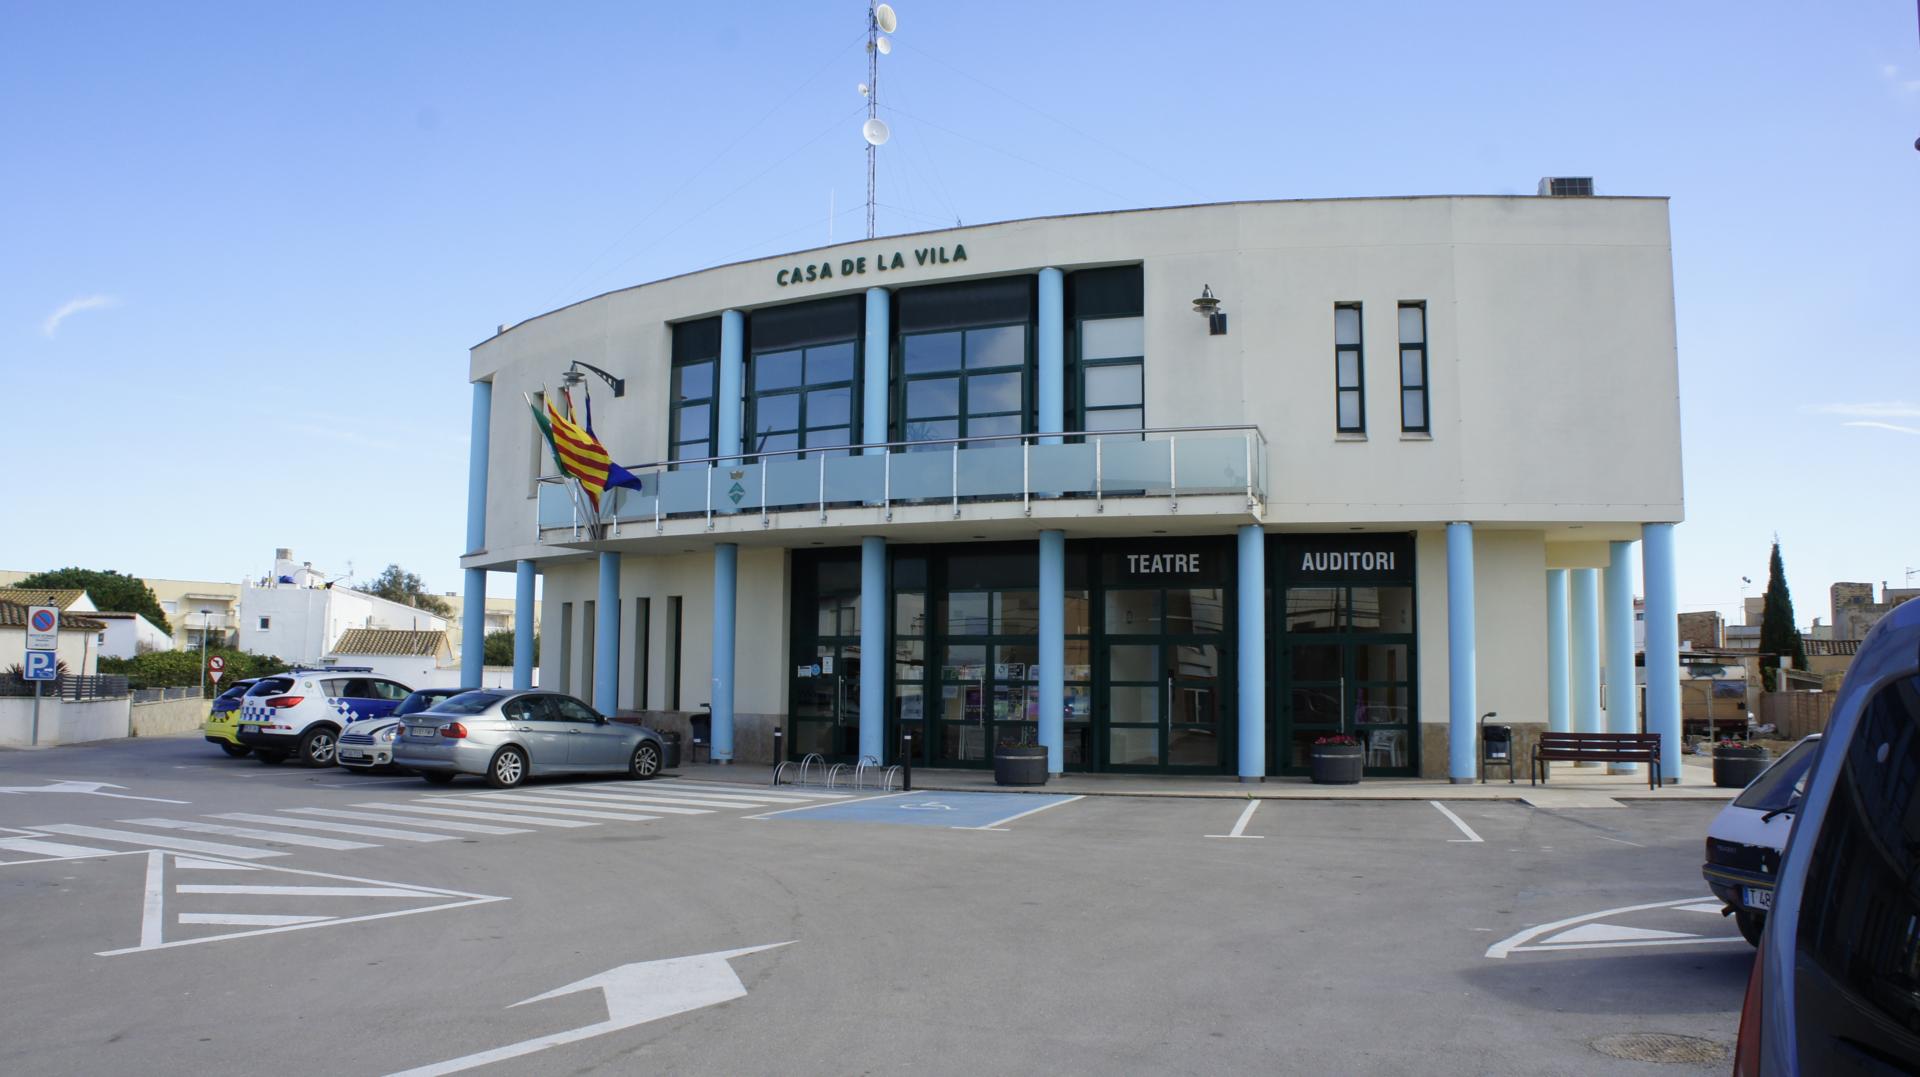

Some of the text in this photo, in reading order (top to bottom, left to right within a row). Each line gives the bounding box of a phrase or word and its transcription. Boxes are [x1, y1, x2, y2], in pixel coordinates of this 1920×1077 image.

[776, 244, 967, 286] CASA DE LA VILA
[1127, 553, 1200, 573] TEATRE
[1302, 551, 1395, 571] AUDITORI
[28, 653, 49, 678] P
